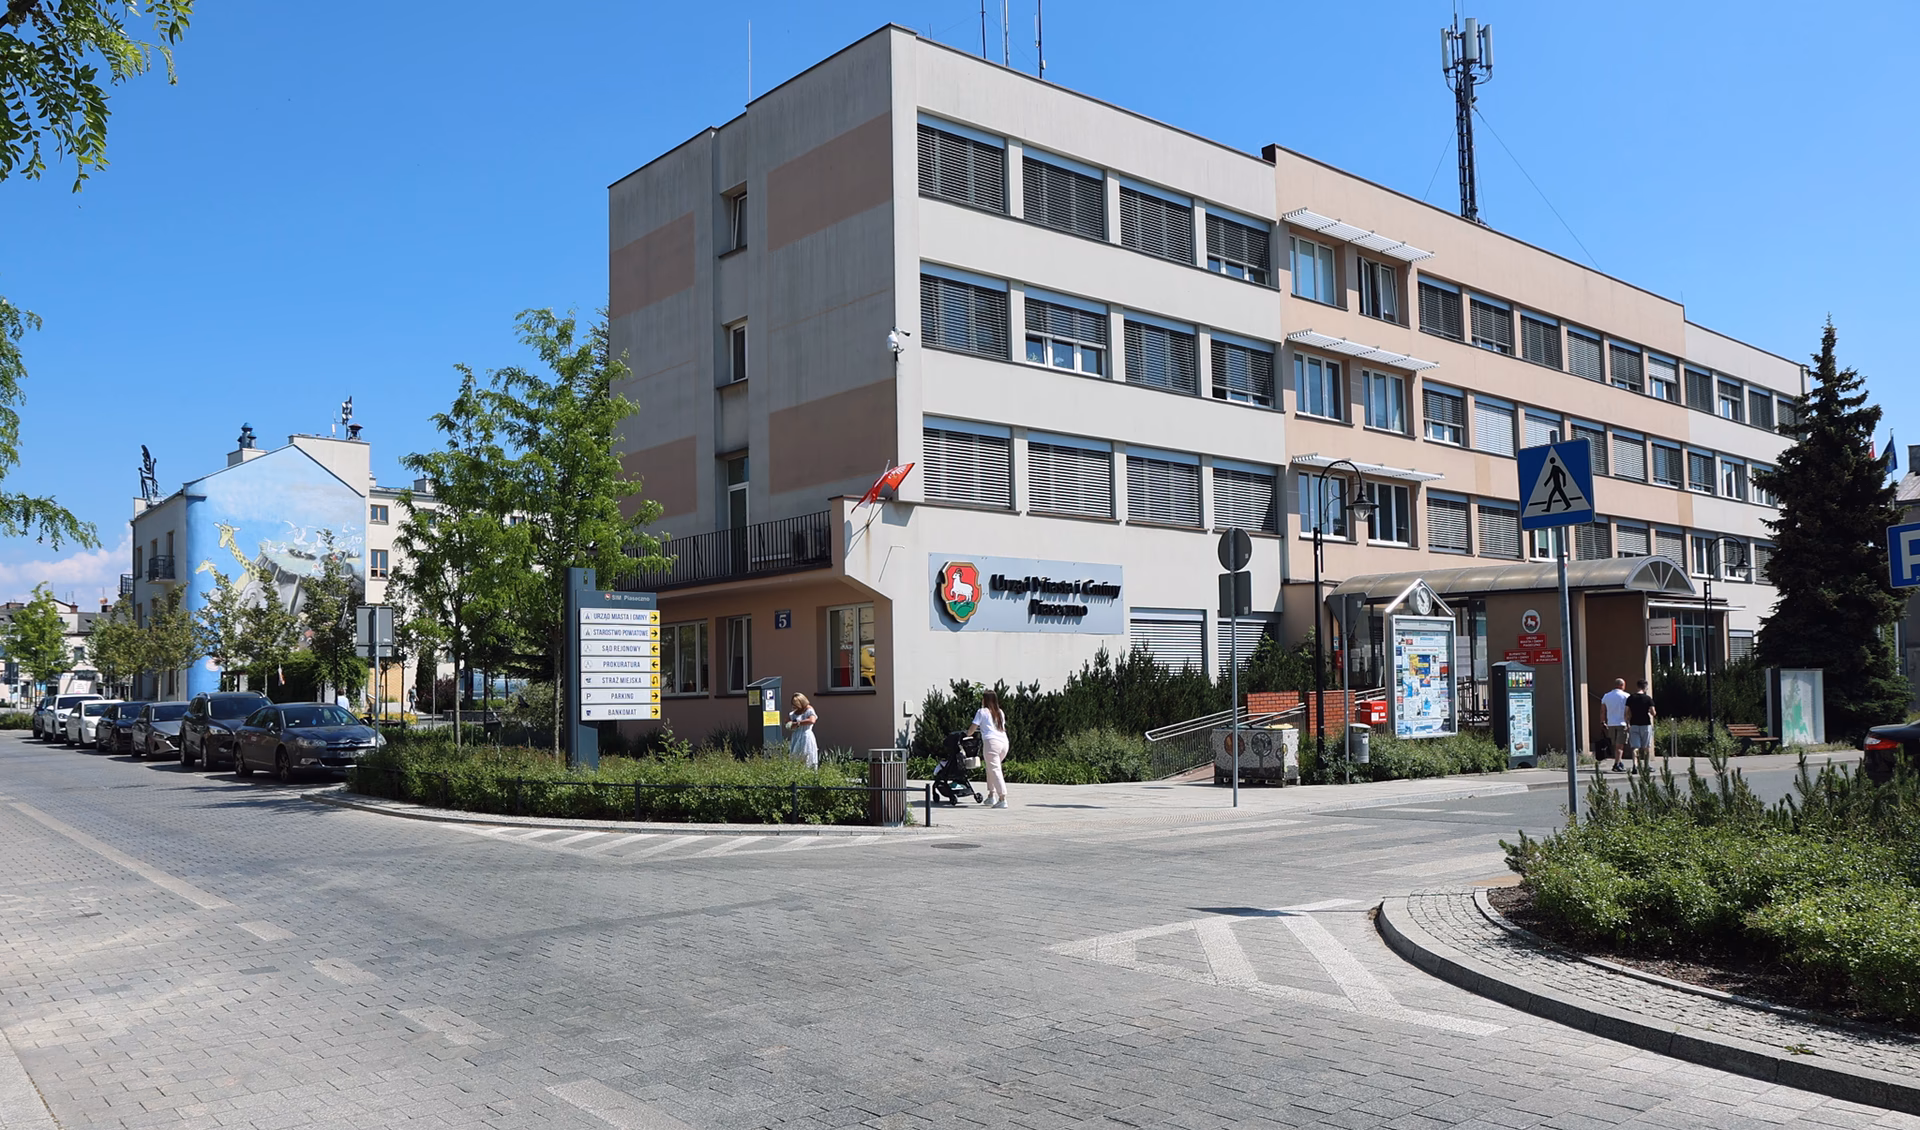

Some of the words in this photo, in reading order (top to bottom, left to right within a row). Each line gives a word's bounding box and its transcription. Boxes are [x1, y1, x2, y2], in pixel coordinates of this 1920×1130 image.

[623, 594, 651, 602] Piaseczno
[593, 613, 610, 621] URZĄD
[778, 614, 788, 628] 5
[602, 645, 613, 653] SĄD
[602, 676, 619, 684] STRAŻ
[766, 690, 774, 700] P
